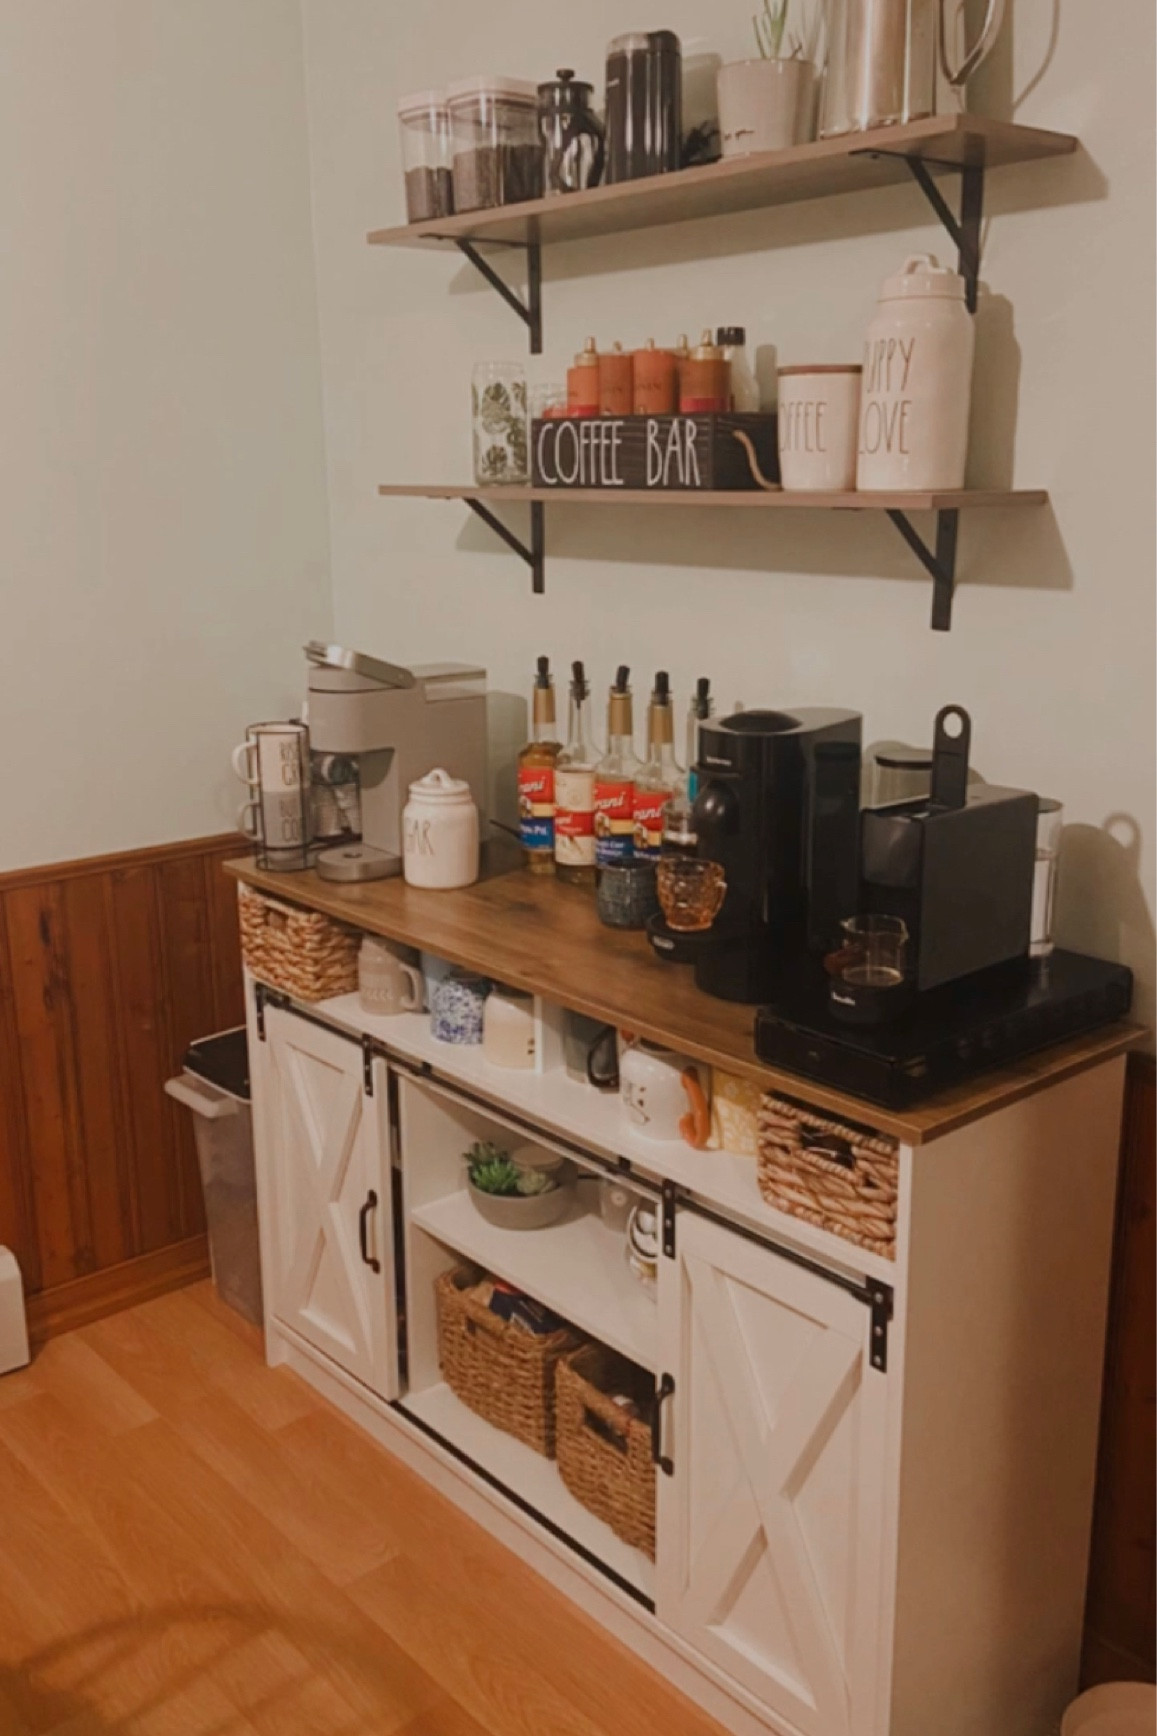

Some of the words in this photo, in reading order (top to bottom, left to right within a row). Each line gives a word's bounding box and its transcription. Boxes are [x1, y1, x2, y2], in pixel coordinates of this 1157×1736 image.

[864, 337, 916, 394] UPPY
[536, 419, 624, 487] COFFEE
[646, 417, 702, 488] BAR
[780, 400, 828, 454] OFFEE
